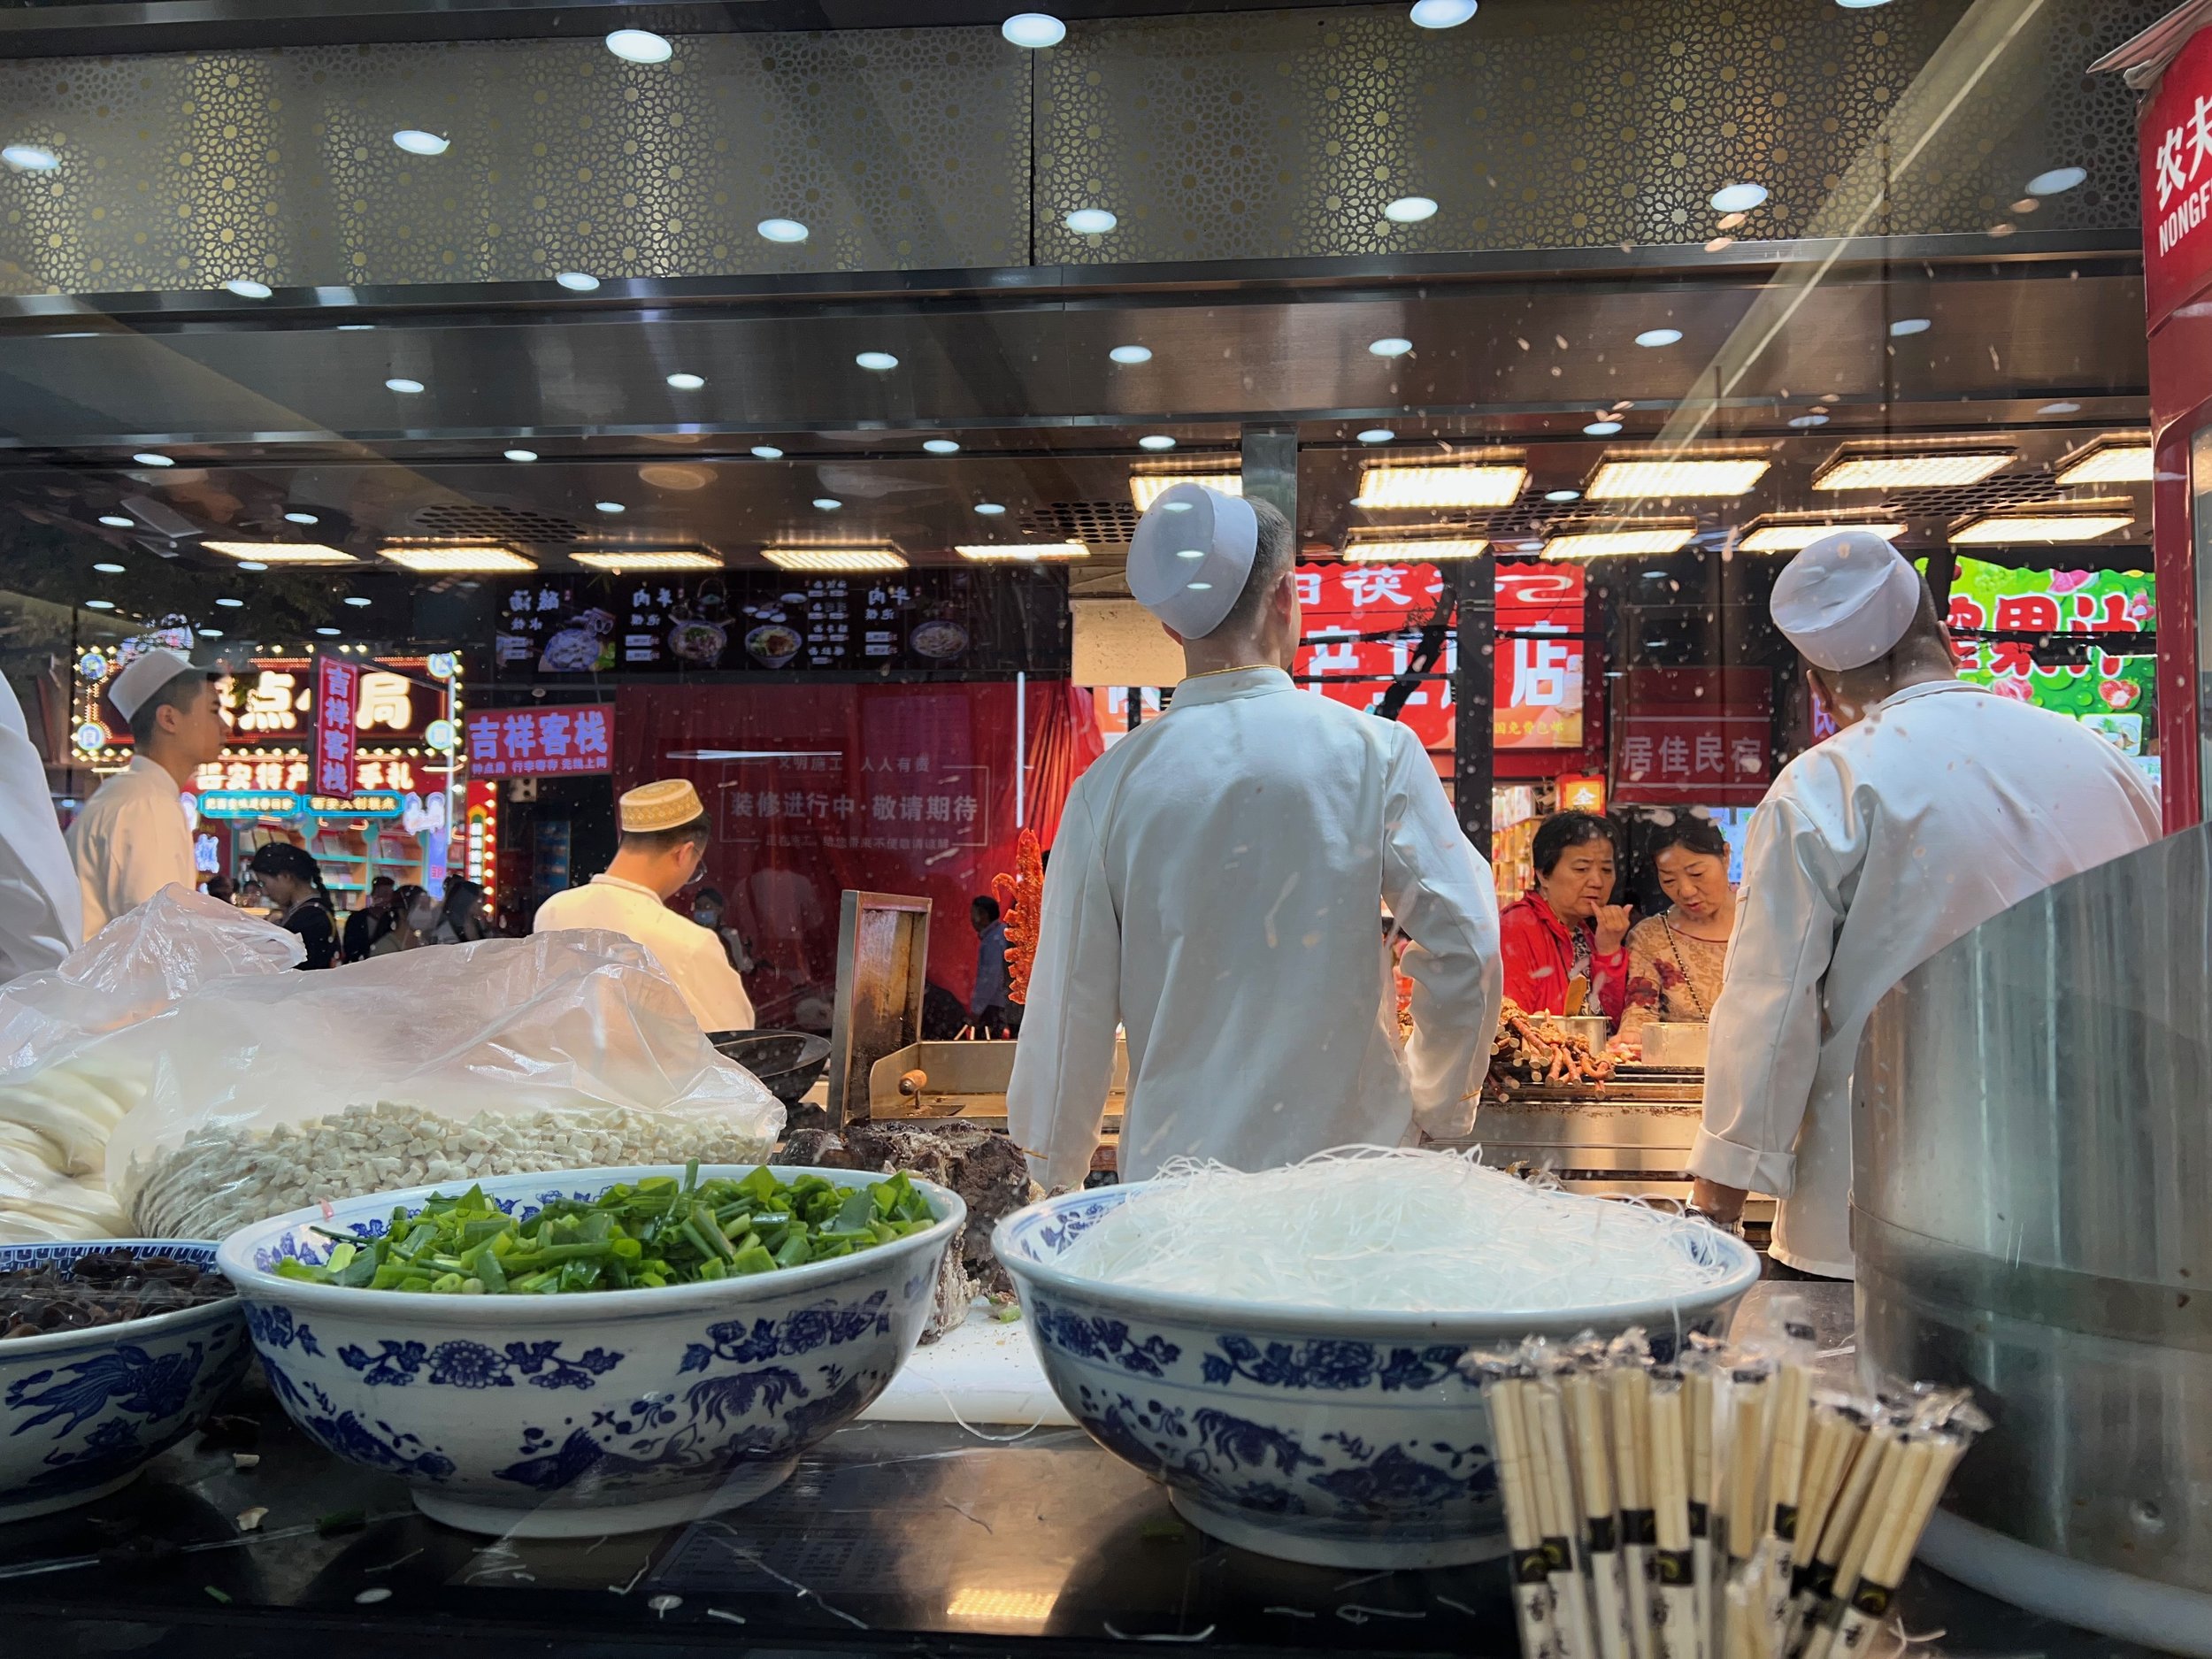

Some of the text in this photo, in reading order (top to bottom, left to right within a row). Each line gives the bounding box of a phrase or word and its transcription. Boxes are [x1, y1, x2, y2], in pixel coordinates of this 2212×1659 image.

[2158, 178, 2212, 257] NONGF
[214, 670, 412, 731] 点局
[322, 664, 353, 794] 吉祥客栈
[469, 710, 608, 760] 吉祥客栈
[1622, 735, 1763, 773] 居佳民宿
[196, 762, 414, 790] 西安特产手礼
[562, 755, 608, 771] 无线上网
